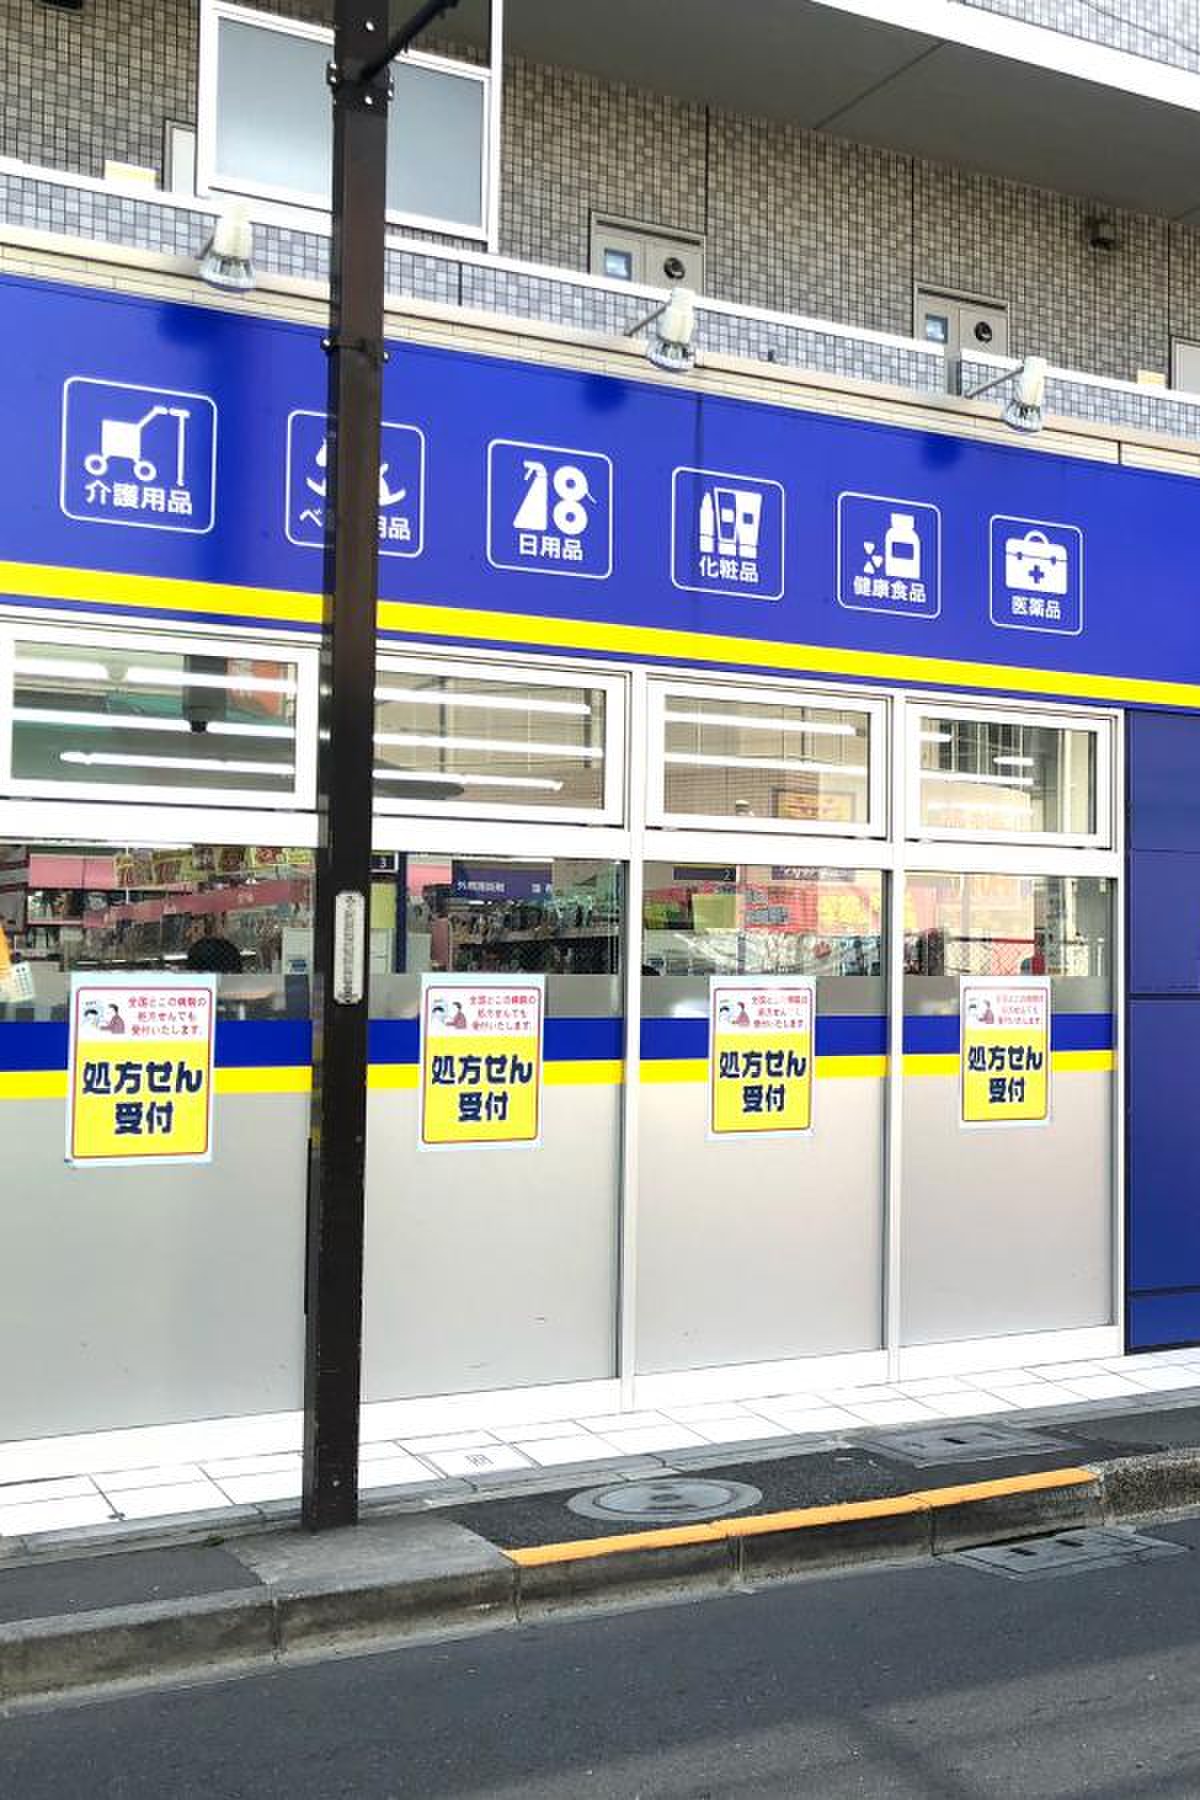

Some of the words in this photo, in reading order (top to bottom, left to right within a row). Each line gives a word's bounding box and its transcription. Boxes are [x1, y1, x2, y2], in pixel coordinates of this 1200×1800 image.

[84, 480, 194, 515] 介護用品
[518, 532, 585, 562] 日用品
[698, 557, 760, 584] 化粧品
[851, 575, 928, 605] 健康食品
[1010, 594, 1062, 620] 医薬品
[431, 1053, 534, 1085] 処方せん
[719, 1050, 807, 1079] 処方せん
[968, 1045, 1043, 1072] 処方せん
[82, 1060, 203, 1094] 処方せん
[988, 1076, 1025, 1104] 受付
[458, 1091, 509, 1122] 受付
[742, 1084, 786, 1113] 受付
[114, 1101, 174, 1135] 受付
